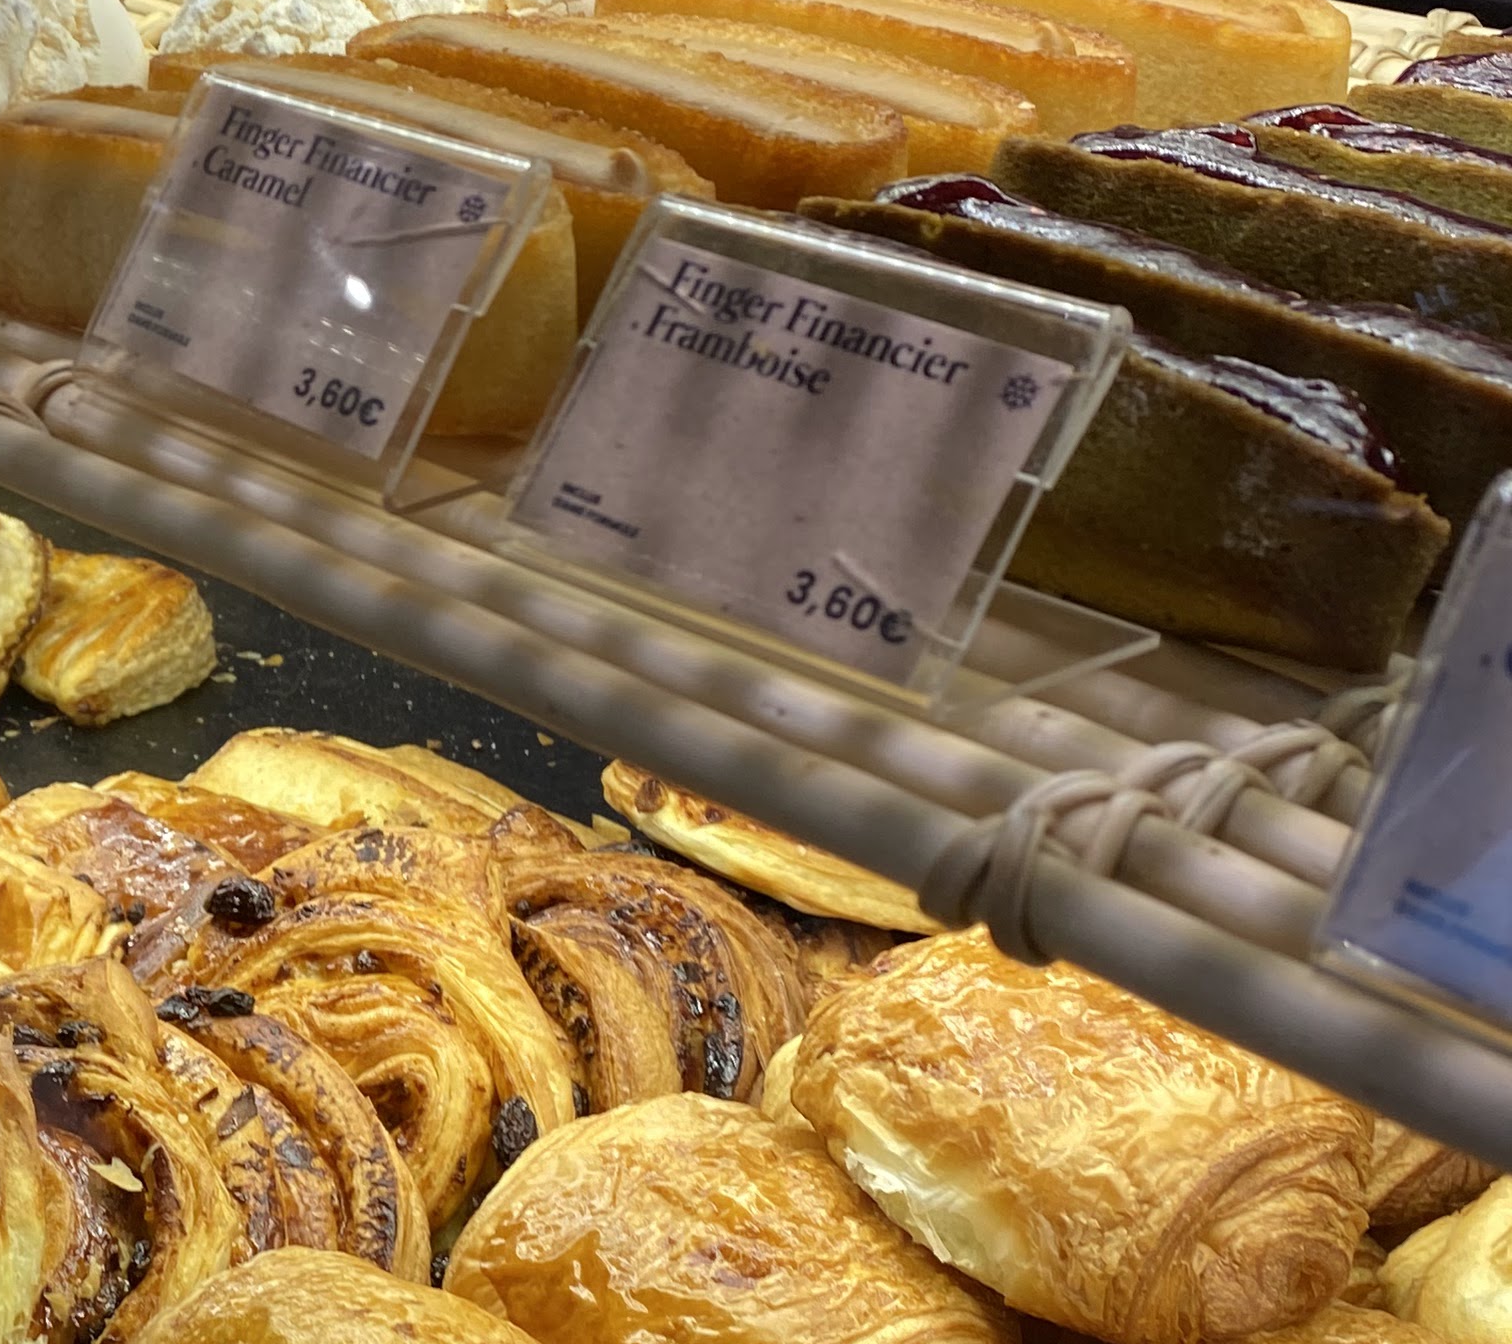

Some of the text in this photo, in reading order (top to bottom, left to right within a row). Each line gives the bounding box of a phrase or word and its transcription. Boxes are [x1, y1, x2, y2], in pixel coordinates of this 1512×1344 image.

[203, 145, 313, 208] Caramel
[219, 106, 437, 206] Finger Financier
[643, 304, 833, 395] Framboise
[669, 260, 970, 386] Finger Financier
[294, 367, 386, 426] 3,60€
[787, 570, 914, 644] 3,60€
